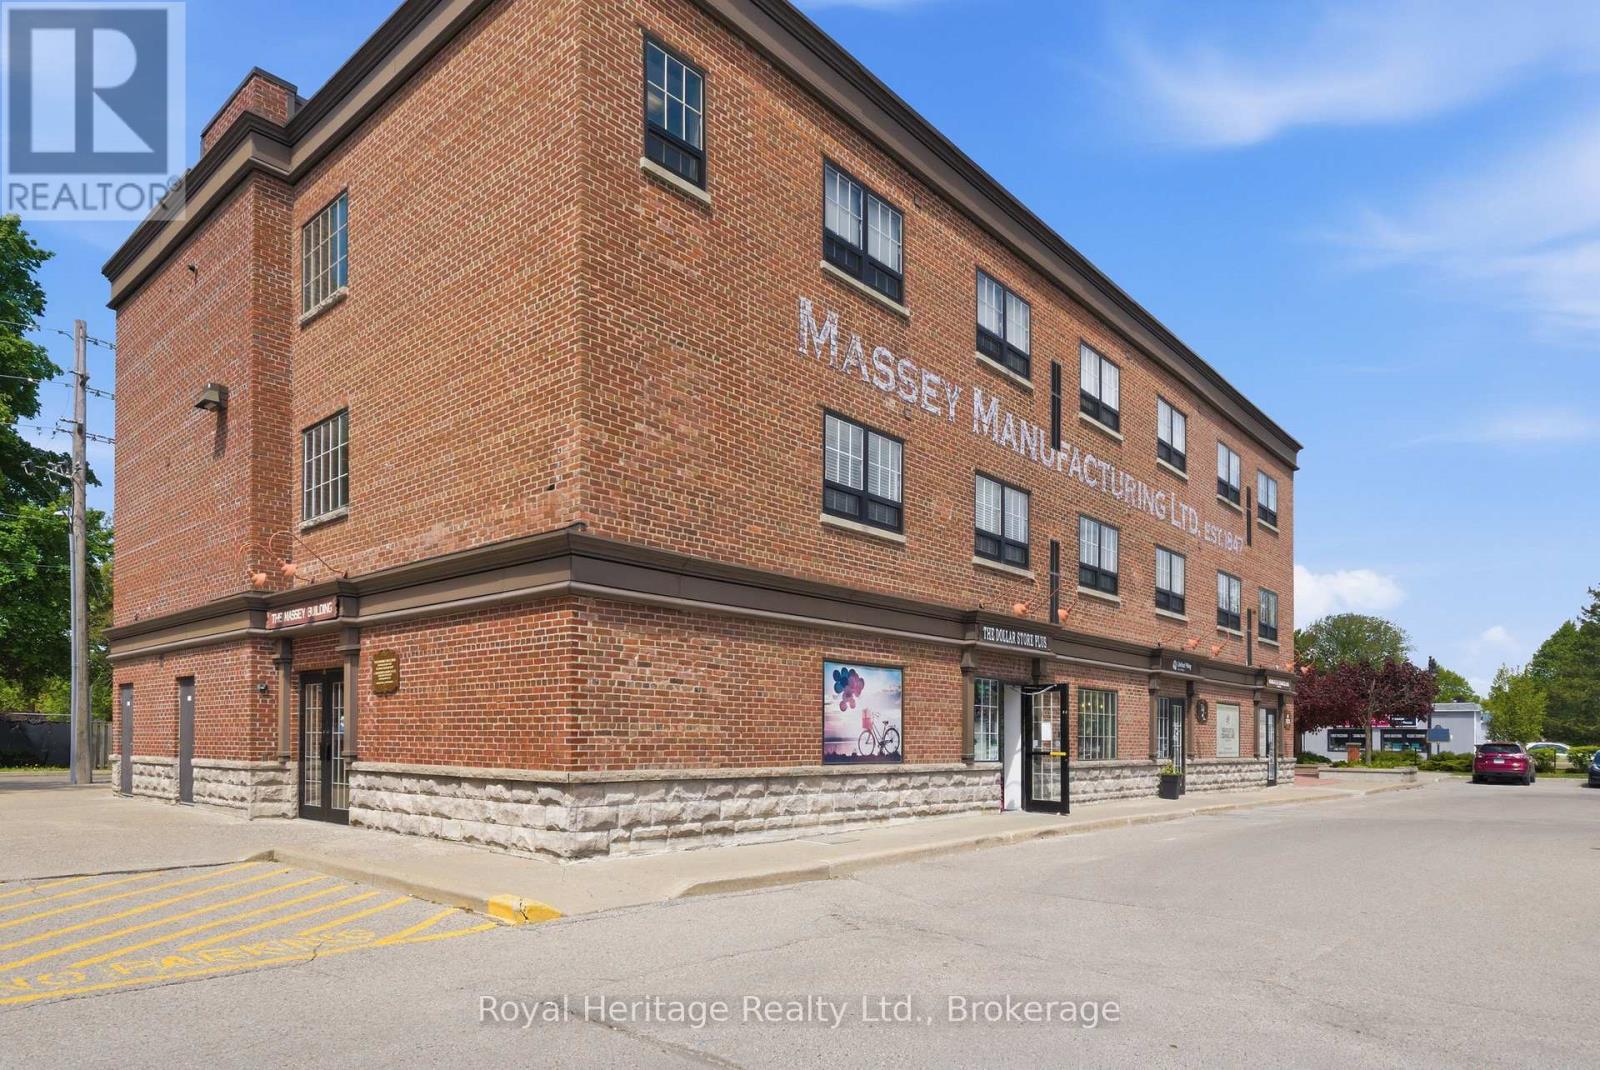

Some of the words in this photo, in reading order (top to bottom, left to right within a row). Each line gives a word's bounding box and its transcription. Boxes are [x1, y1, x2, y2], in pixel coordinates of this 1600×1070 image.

[798, 296, 962, 423] MASSEY
[972, 386, 1166, 521] MANUFACTURING
[271, 612, 283, 624] THE
[284, 607, 306, 622] MASSEY
[307, 601, 333, 618] BUILDING
[983, 626, 995, 641] THE
[996, 628, 1016, 645] DOLLAR
[1017, 631, 1034, 647] STORE
[1034, 635, 1048, 649] PLUS
